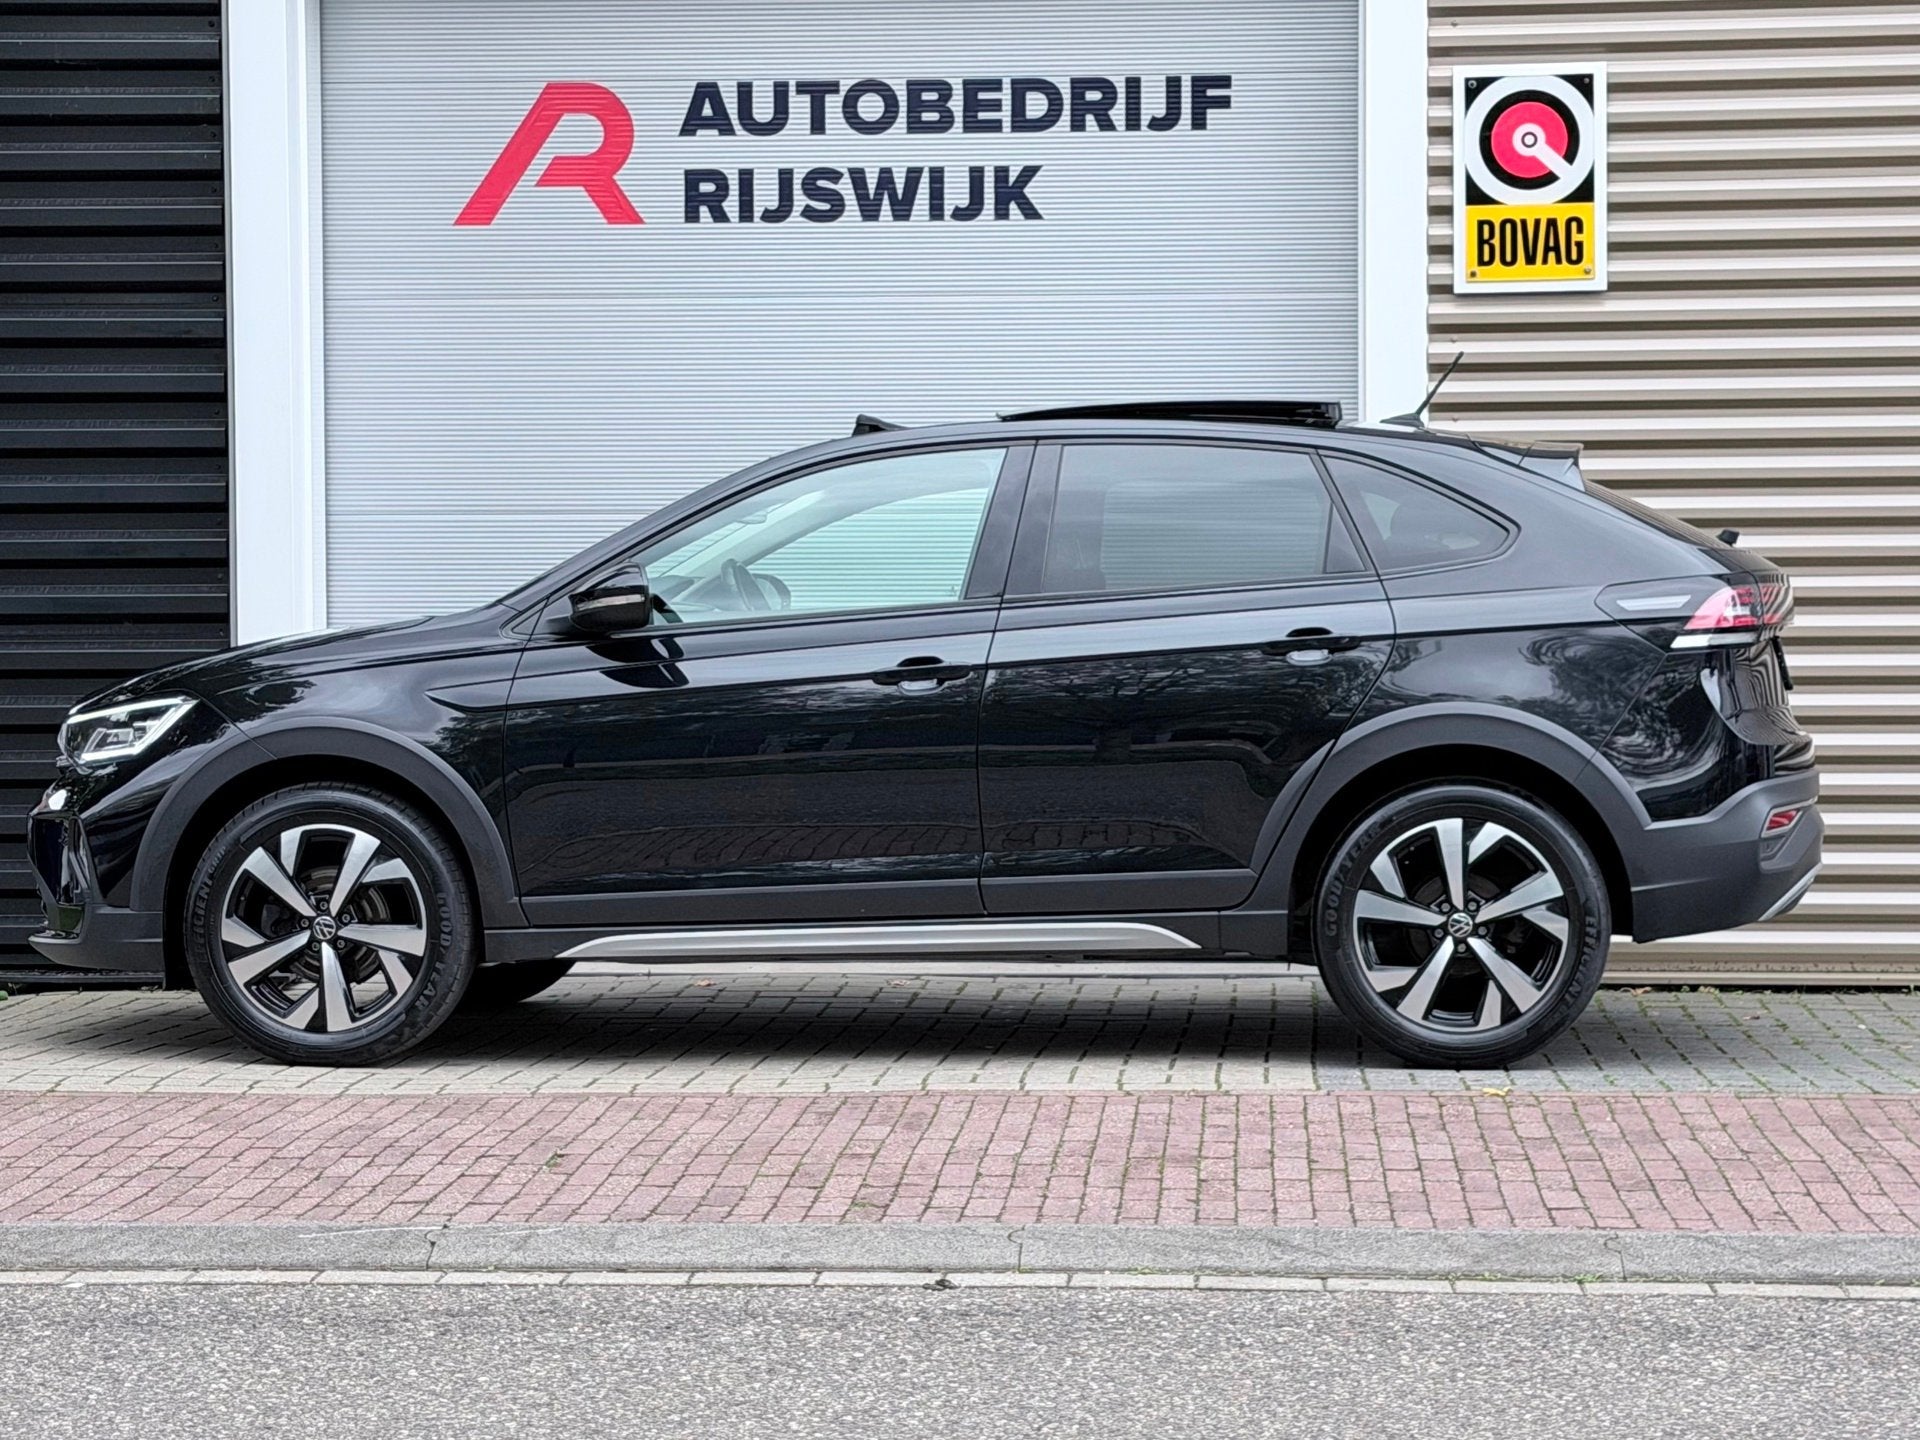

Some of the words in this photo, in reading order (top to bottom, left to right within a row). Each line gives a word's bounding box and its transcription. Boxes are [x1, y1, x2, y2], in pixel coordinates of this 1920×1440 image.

[679, 75, 1232, 137] AUTOBEDRIJF
[683, 165, 1044, 224] RIJSWIJK
[1476, 216, 1585, 267] BOVAG
